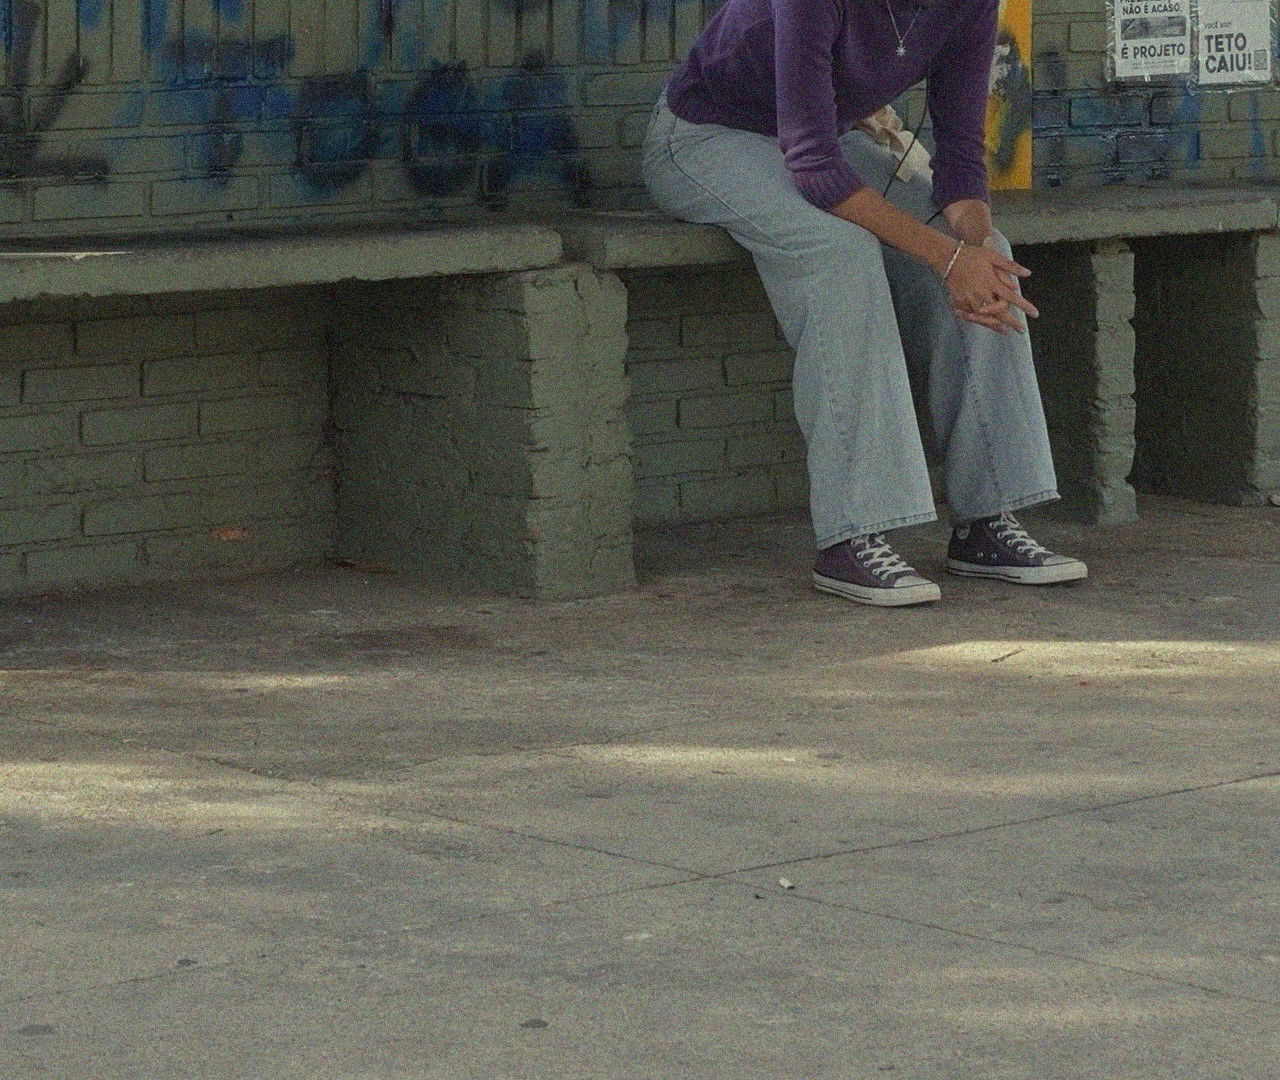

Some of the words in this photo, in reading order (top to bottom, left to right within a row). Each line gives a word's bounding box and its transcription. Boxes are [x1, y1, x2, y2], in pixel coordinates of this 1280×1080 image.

[1122, 3, 1141, 14] NÃO
[1144, 3, 1149, 13] É
[1121, 43, 1129, 59] É
[1133, 43, 1186, 59] PROJETO
[1204, 32, 1247, 53] TETO
[1205, 53, 1252, 73] CAIU!
